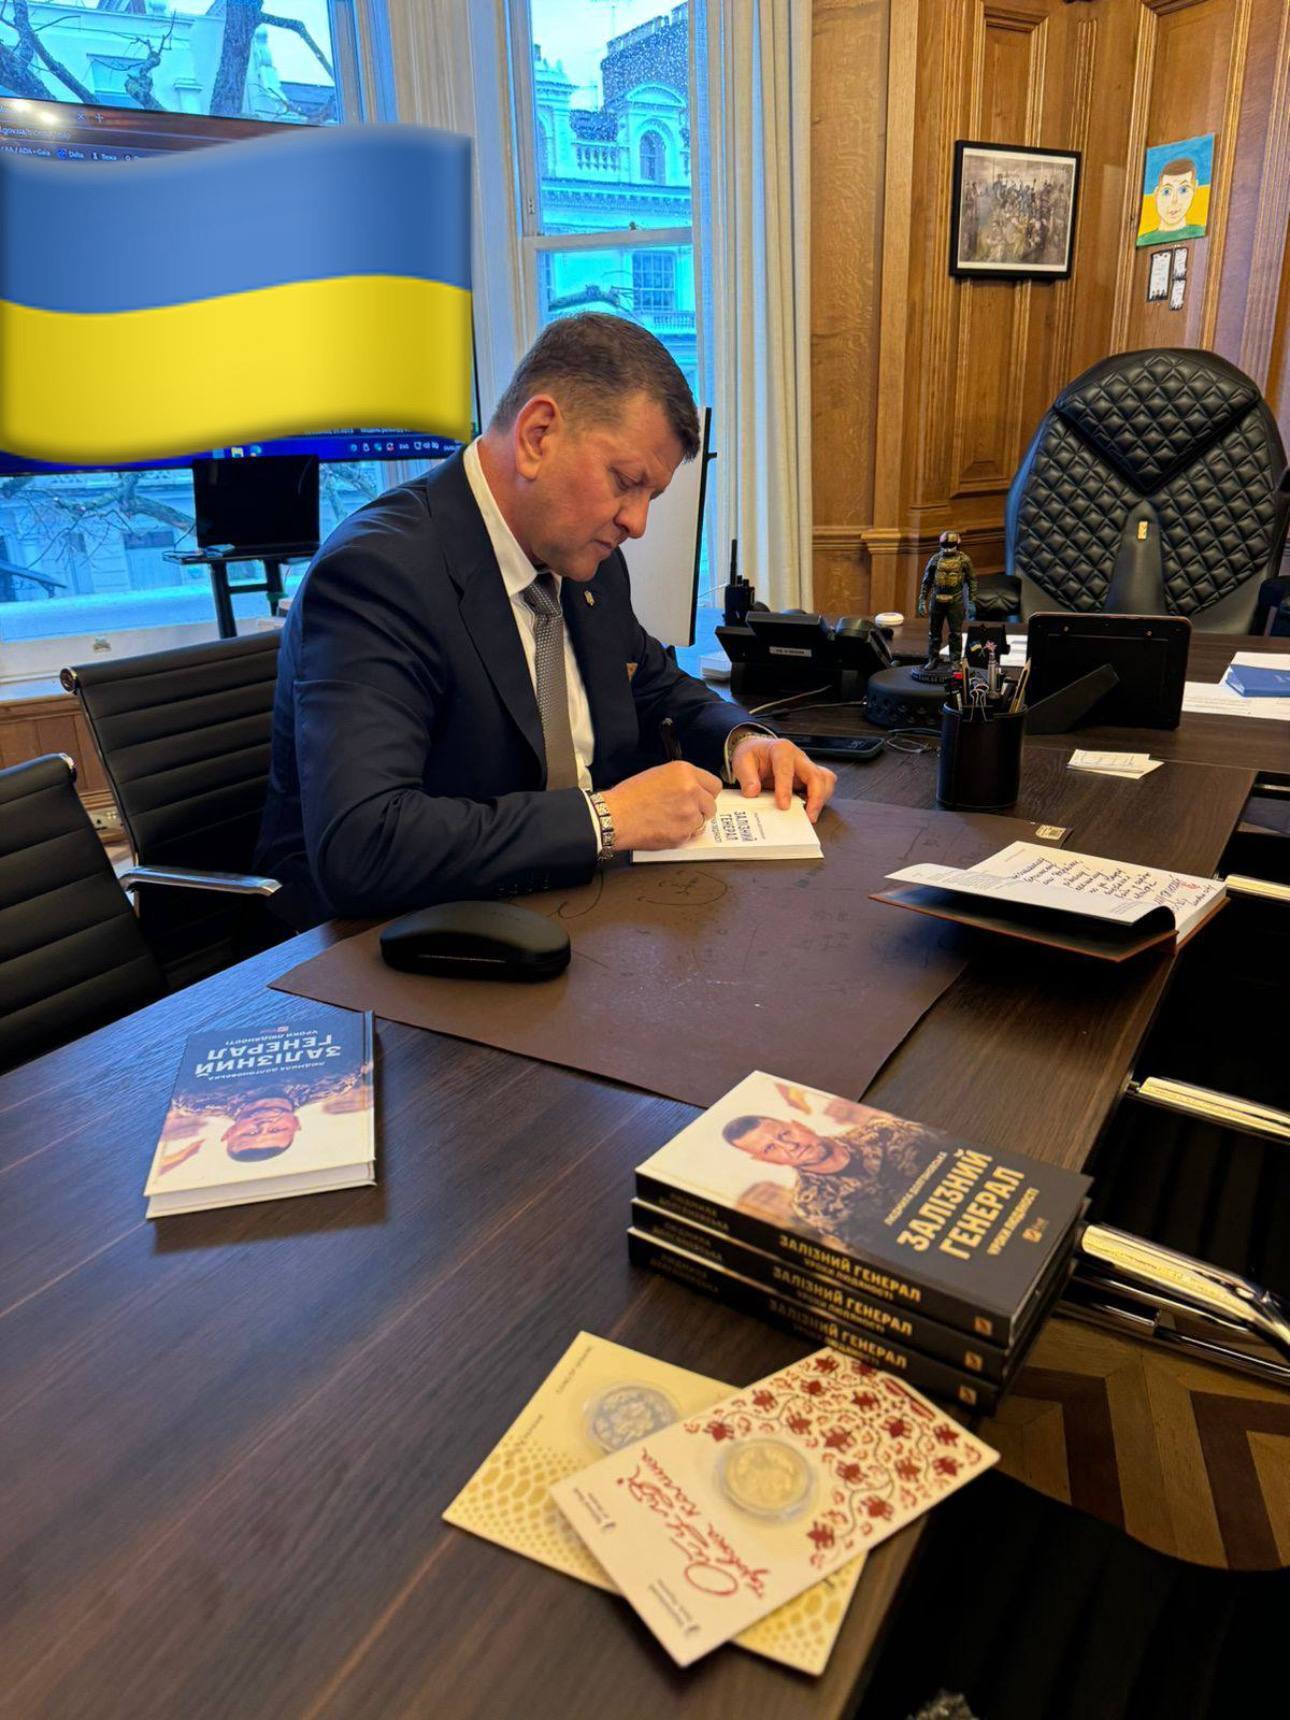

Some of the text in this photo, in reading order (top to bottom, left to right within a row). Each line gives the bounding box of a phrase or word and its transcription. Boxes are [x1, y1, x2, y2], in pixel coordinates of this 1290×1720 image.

[194, 1045, 342, 1078] ЗАЛІЗНИЙ
[207, 1034, 333, 1060] ГЕНЕРАЛ
[896, 1148, 993, 1252] ЗАЛІЗНИЙ
[938, 1165, 1025, 1261] ГЕНЕРАЛ
[773, 1266, 843, 1305] ЗАЛІЗНИЙ
[846, 1297, 913, 1337] ГЕНЕРАЛ
[779, 1234, 922, 1303] ЗАЛІЗНИЙ ГЕНЕРАЛ
[840, 1330, 908, 1370] ГЕНЕРАЛ
